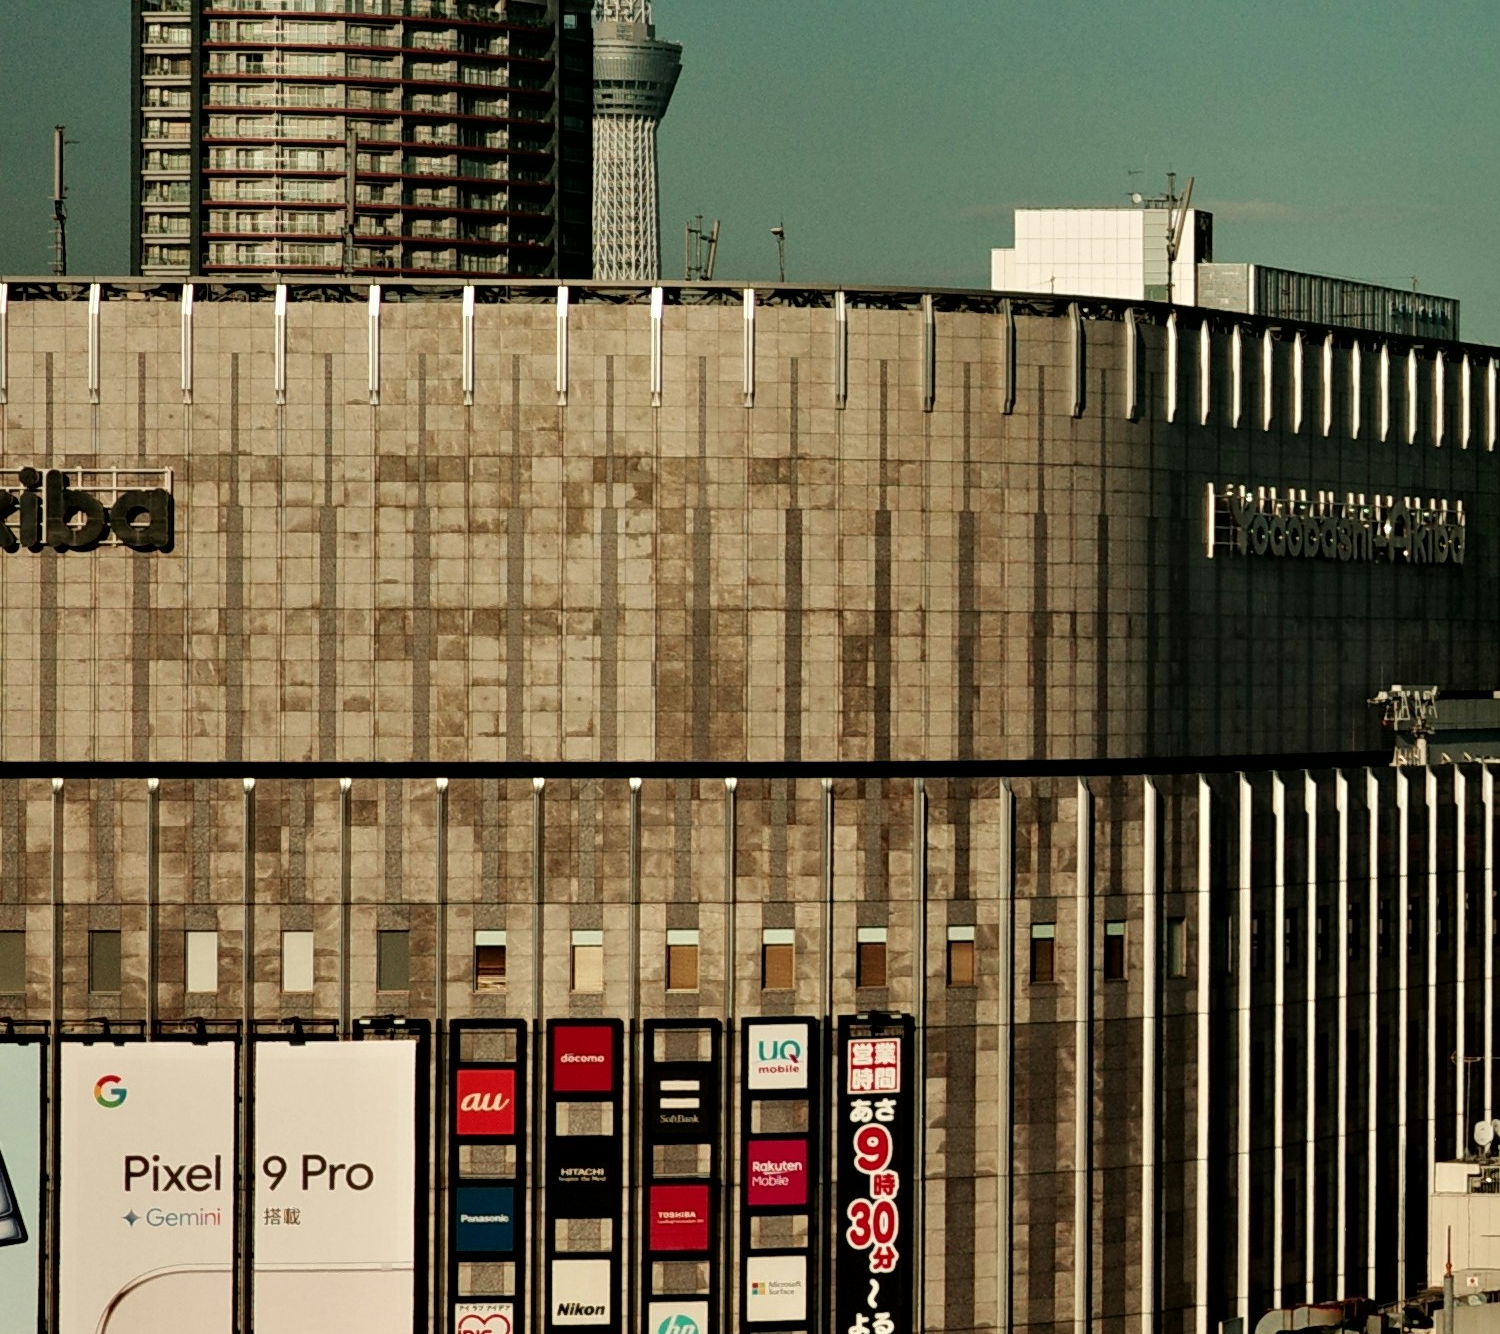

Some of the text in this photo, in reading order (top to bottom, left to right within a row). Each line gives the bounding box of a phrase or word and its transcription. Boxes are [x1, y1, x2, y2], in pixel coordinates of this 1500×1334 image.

[758, 1040, 801, 1064] UQ
[560, 1054, 605, 1063] docomo
[758, 1065, 800, 1074] mobile
[461, 1092, 510, 1112] au
[850, 1098, 897, 1122] あさ
[660, 1114, 699, 1124] SoftBank
[752, 1160, 803, 1173] Rakuten
[124, 1154, 374, 1192] Pixel 9 Pro
[560, 1168, 605, 1176] HITACHI
[752, 1176, 789, 1186] Mobile
[146, 1207, 301, 1227] Gemini 搭載
[460, 1214, 509, 1223] Panasonic
[657, 1211, 697, 1219] TOSHIBA
[768, 1280, 802, 1288] Microsoft
[557, 1302, 606, 1316] Nikon
